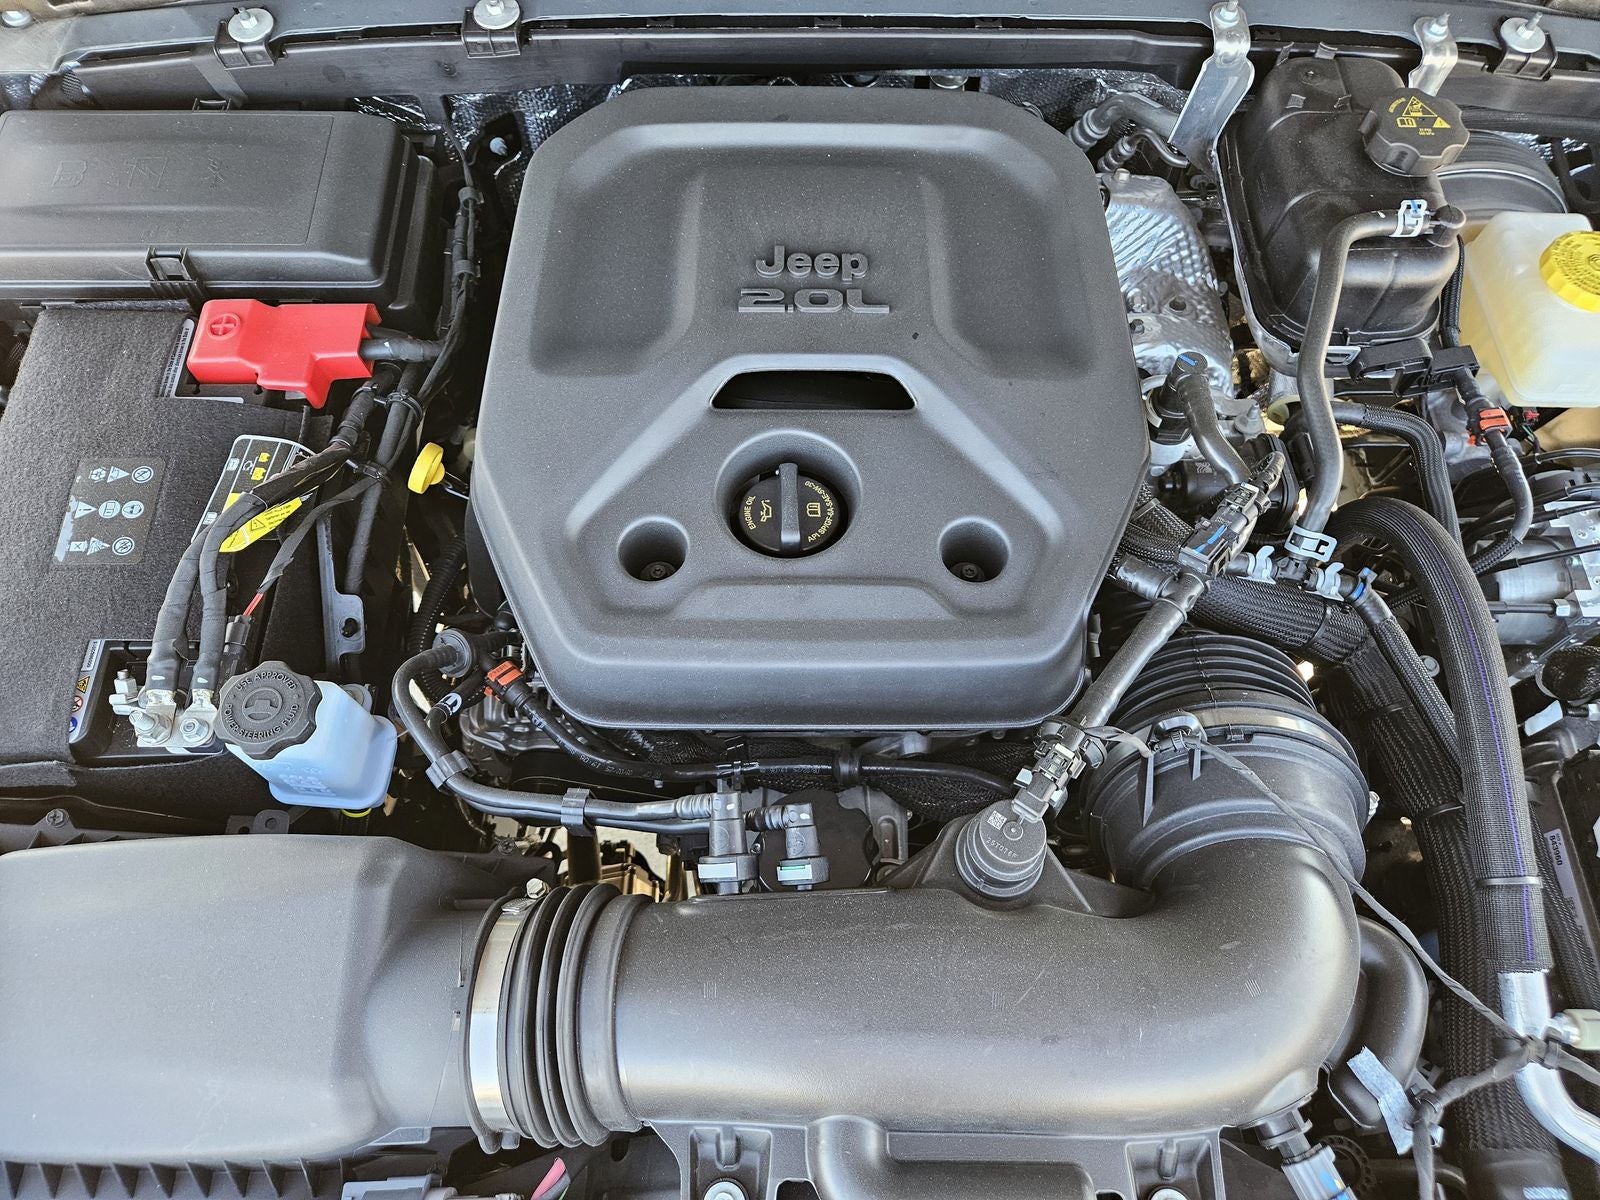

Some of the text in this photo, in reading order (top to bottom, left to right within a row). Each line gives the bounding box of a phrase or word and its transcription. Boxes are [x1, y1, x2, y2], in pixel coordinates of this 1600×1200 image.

[755, 246, 868, 284] Jeep
[738, 289, 890, 313] 2.0L
[743, 495, 757, 530] ENGINE OIL
[807, 531, 821, 542] API
[235, 671, 298, 692] USE APPROVED
[224, 703, 300, 740] POWER STEERING FLUID
[1549, 834, 1563, 866] 843960
